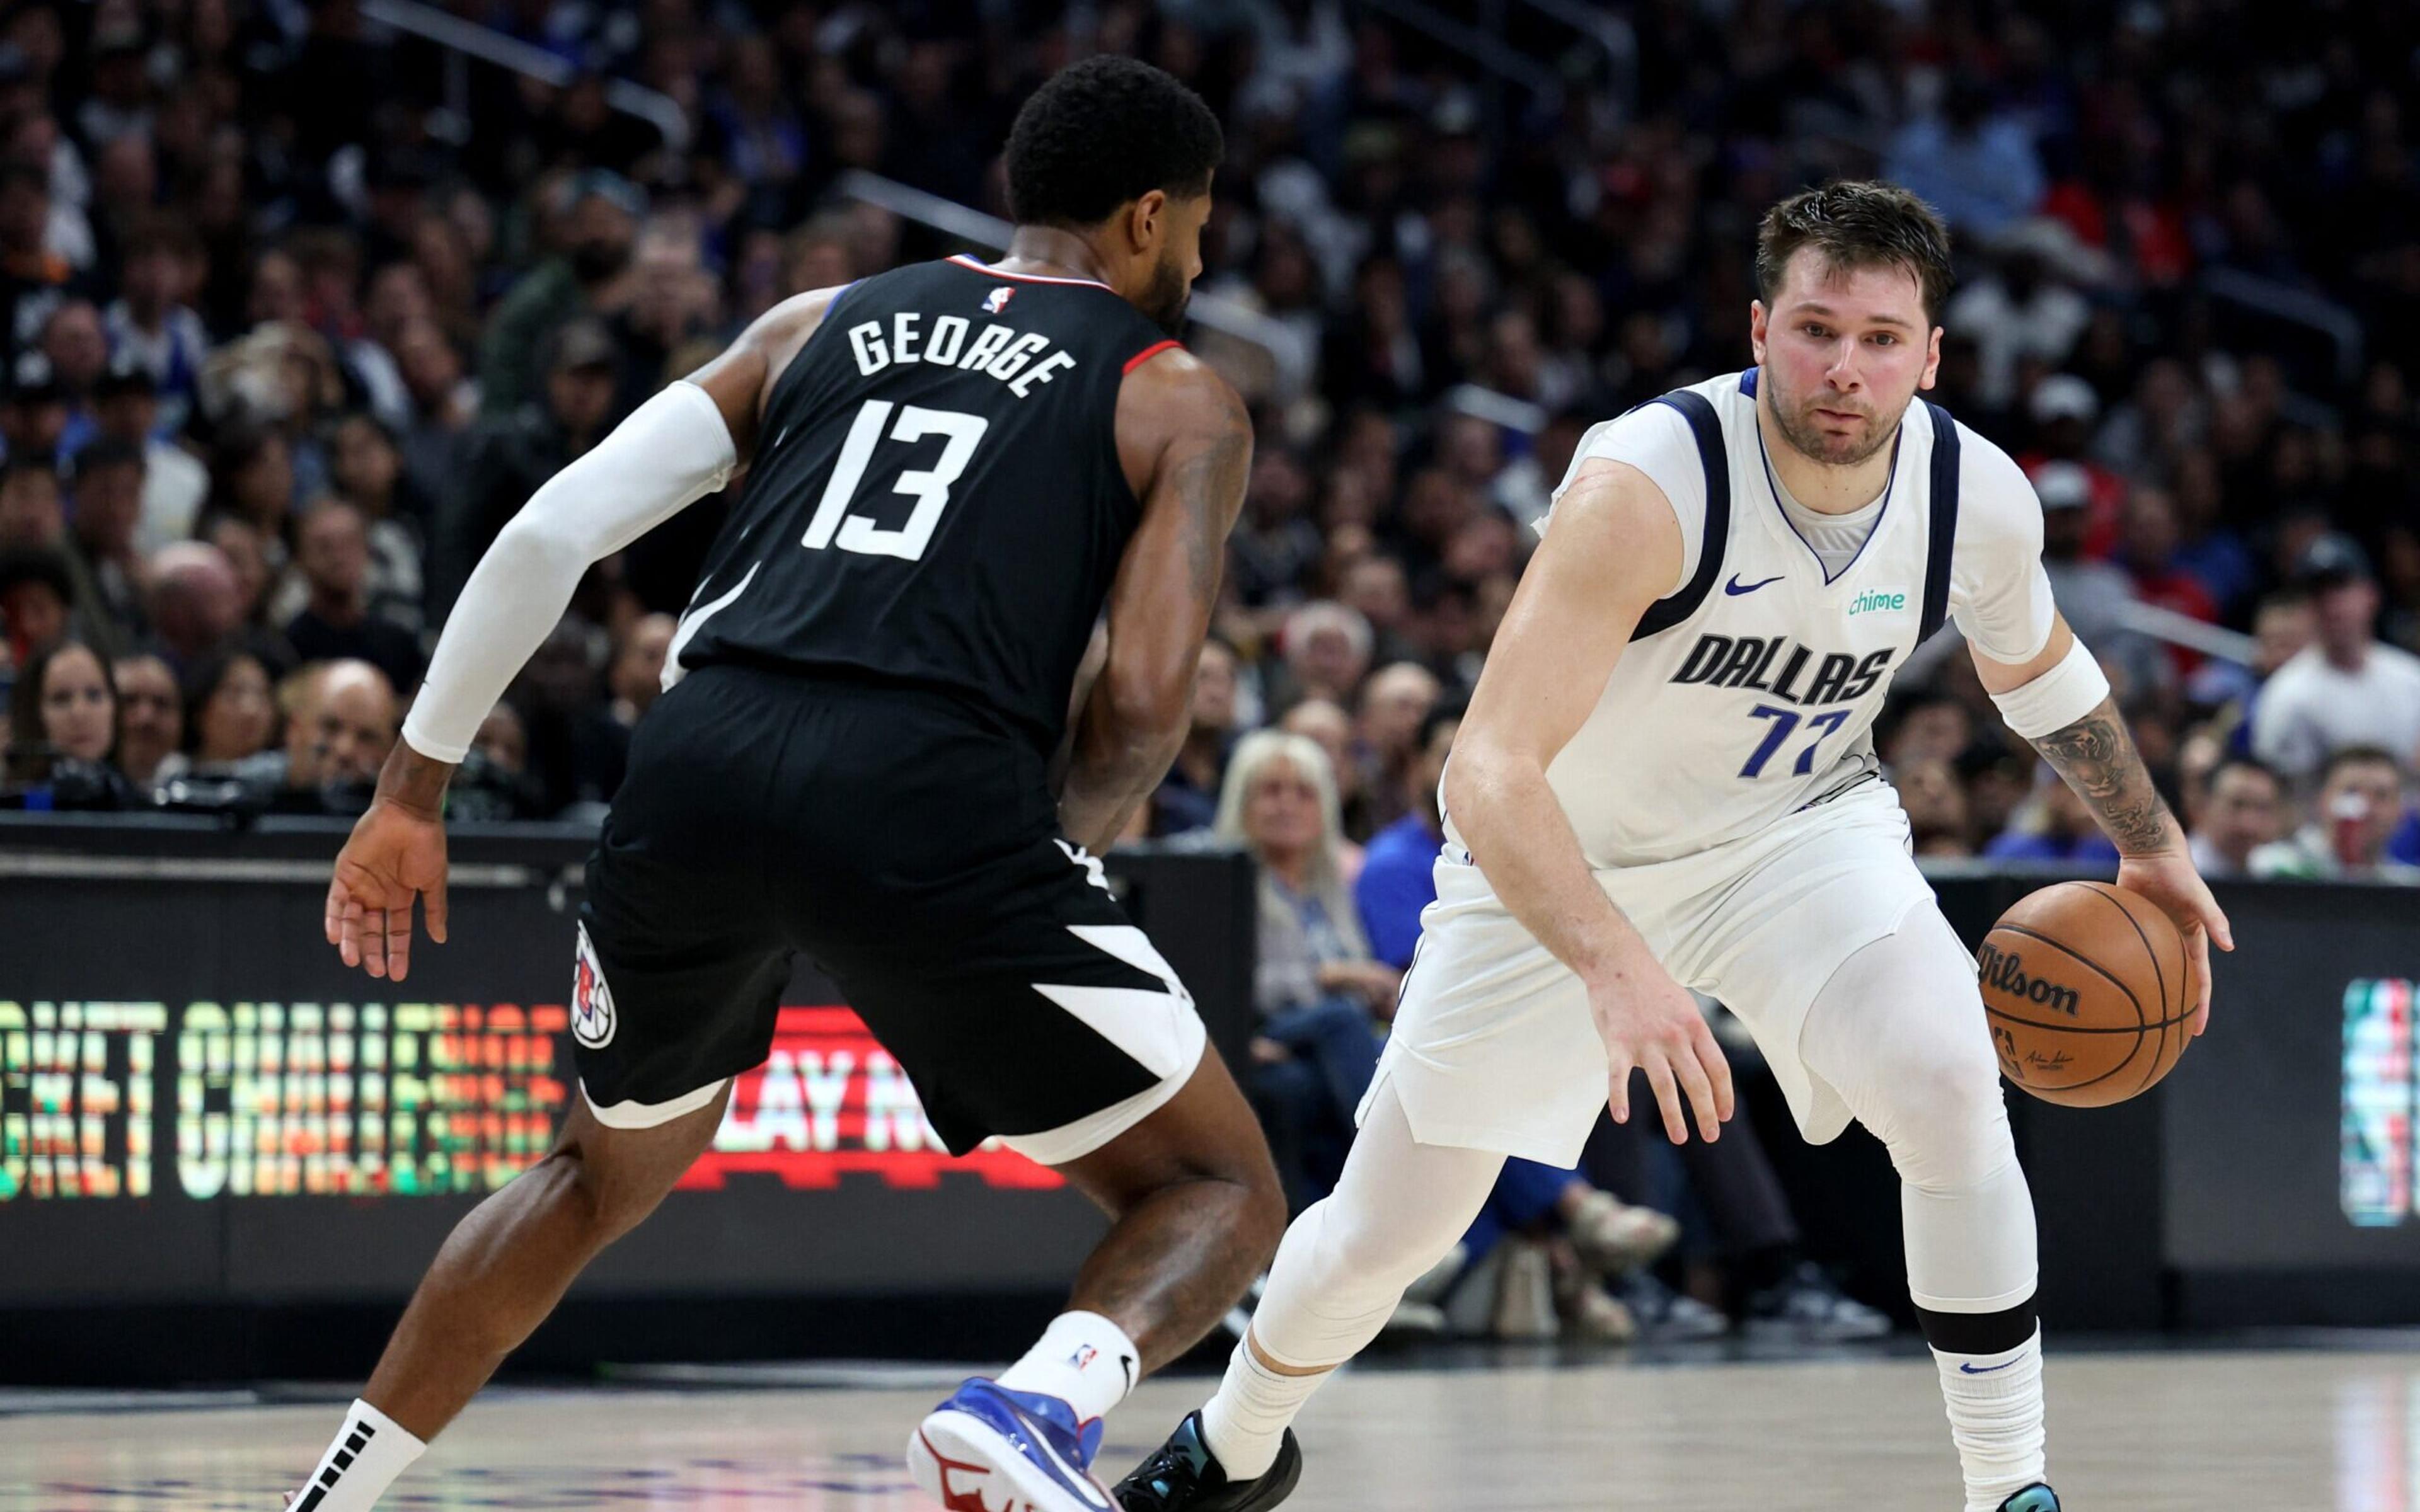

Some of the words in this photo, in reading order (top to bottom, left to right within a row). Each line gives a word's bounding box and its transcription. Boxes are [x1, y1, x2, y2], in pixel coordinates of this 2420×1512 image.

[848, 312, 1076, 398] GEORGE
[801, 399, 989, 561] 13
[1849, 589, 1906, 616] chime
[1668, 633, 1896, 706] DALLAS
[1737, 703, 1853, 779] 77
